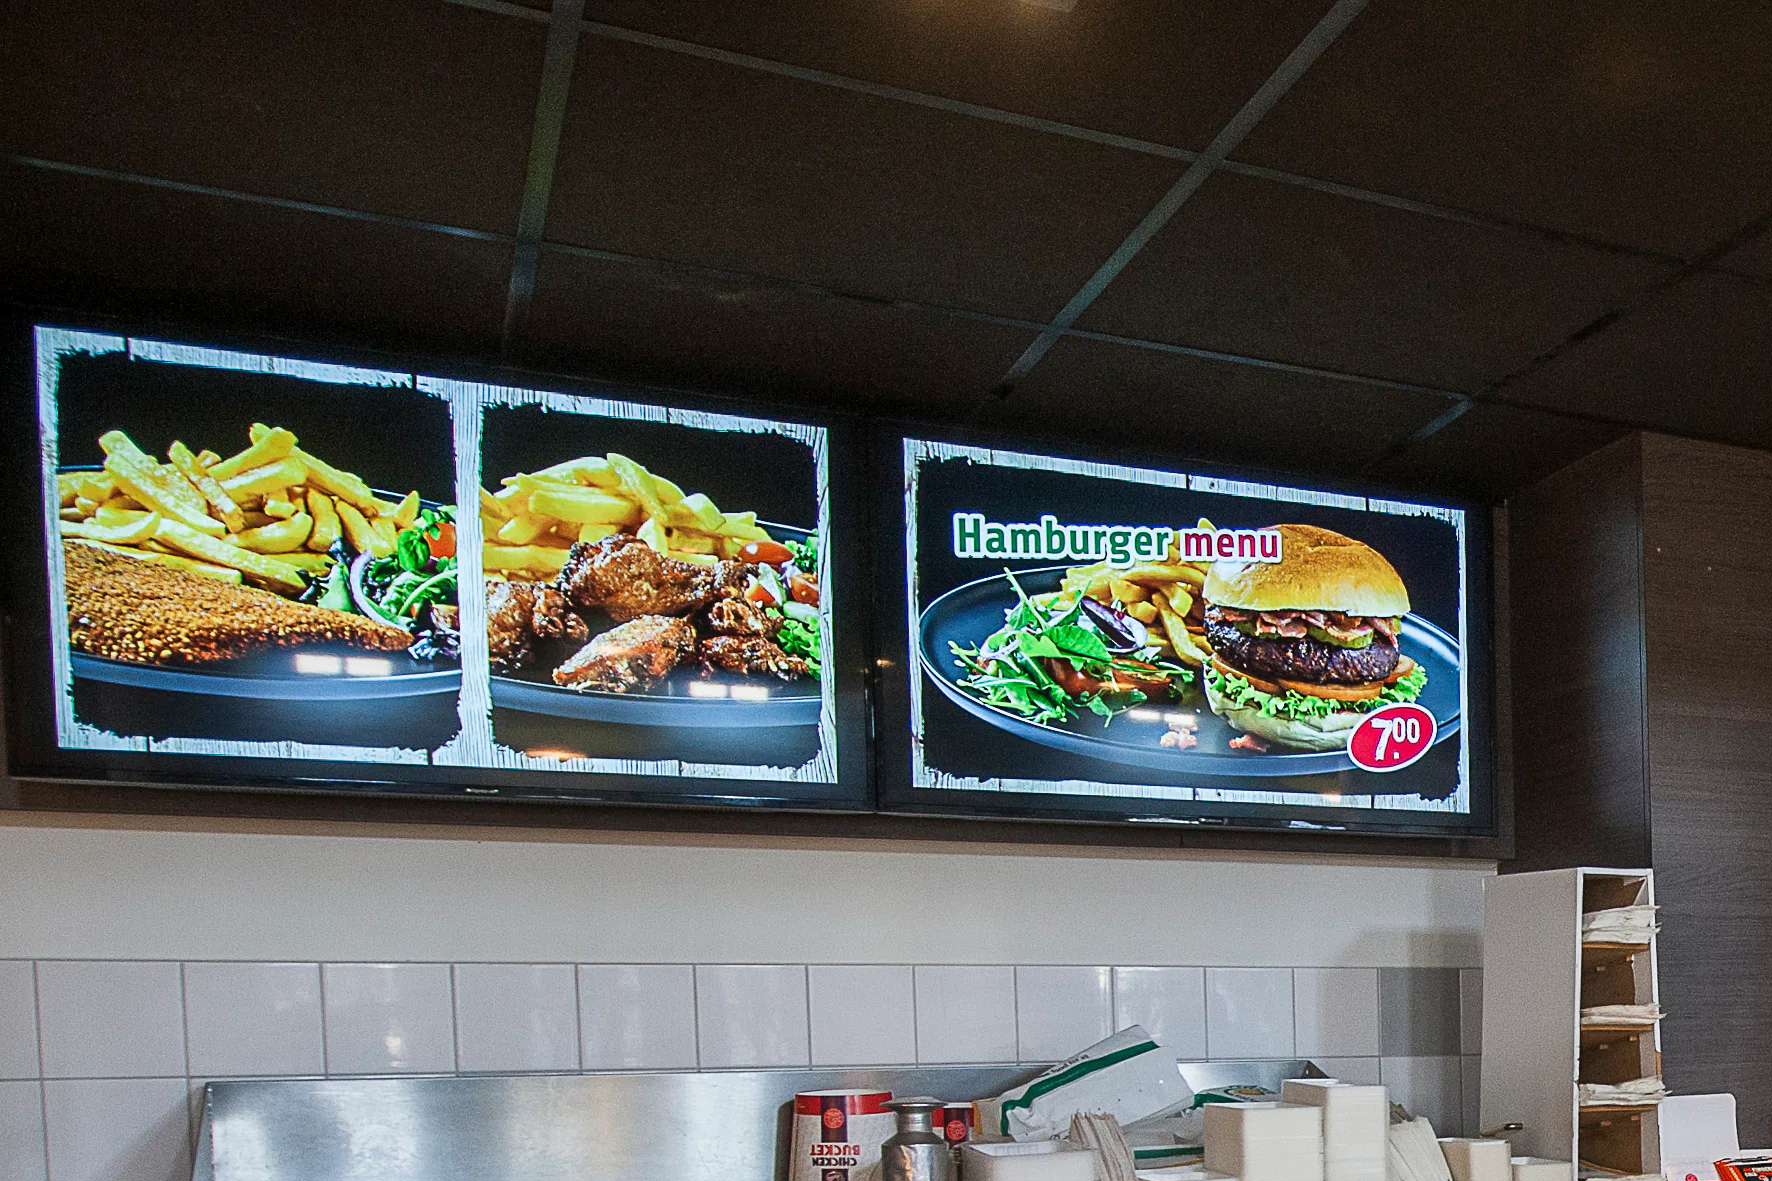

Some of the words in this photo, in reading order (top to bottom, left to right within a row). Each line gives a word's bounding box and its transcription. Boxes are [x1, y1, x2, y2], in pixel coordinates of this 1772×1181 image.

[956, 518, 1169, 563] Hamburger
[1184, 530, 1278, 558] menu
[809, 1144, 860, 1156] BUCKET
[812, 1157, 858, 1167] CHICKEN
